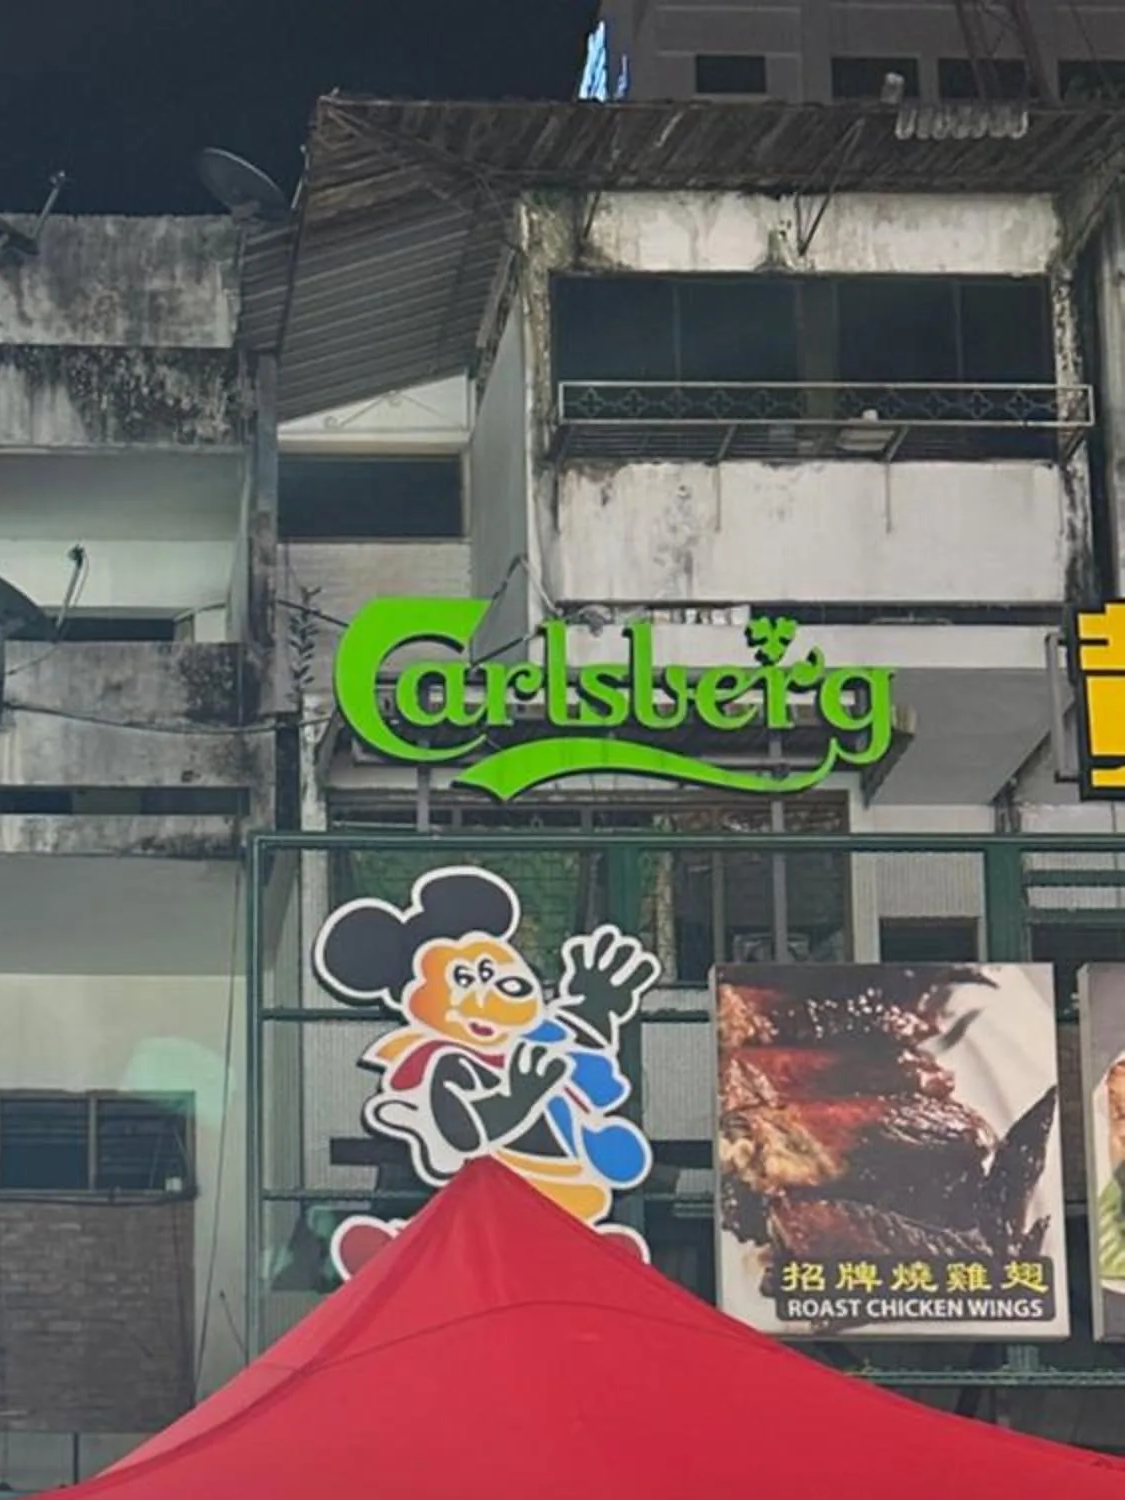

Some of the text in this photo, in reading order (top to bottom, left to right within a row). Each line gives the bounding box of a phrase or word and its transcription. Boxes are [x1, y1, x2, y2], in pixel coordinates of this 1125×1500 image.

[334, 598, 896, 775] Carlsberg
[780, 1259, 1050, 1293] 招牌燒雞翅
[788, 1298, 1044, 1319] ROAST CHICKEN WINGS
